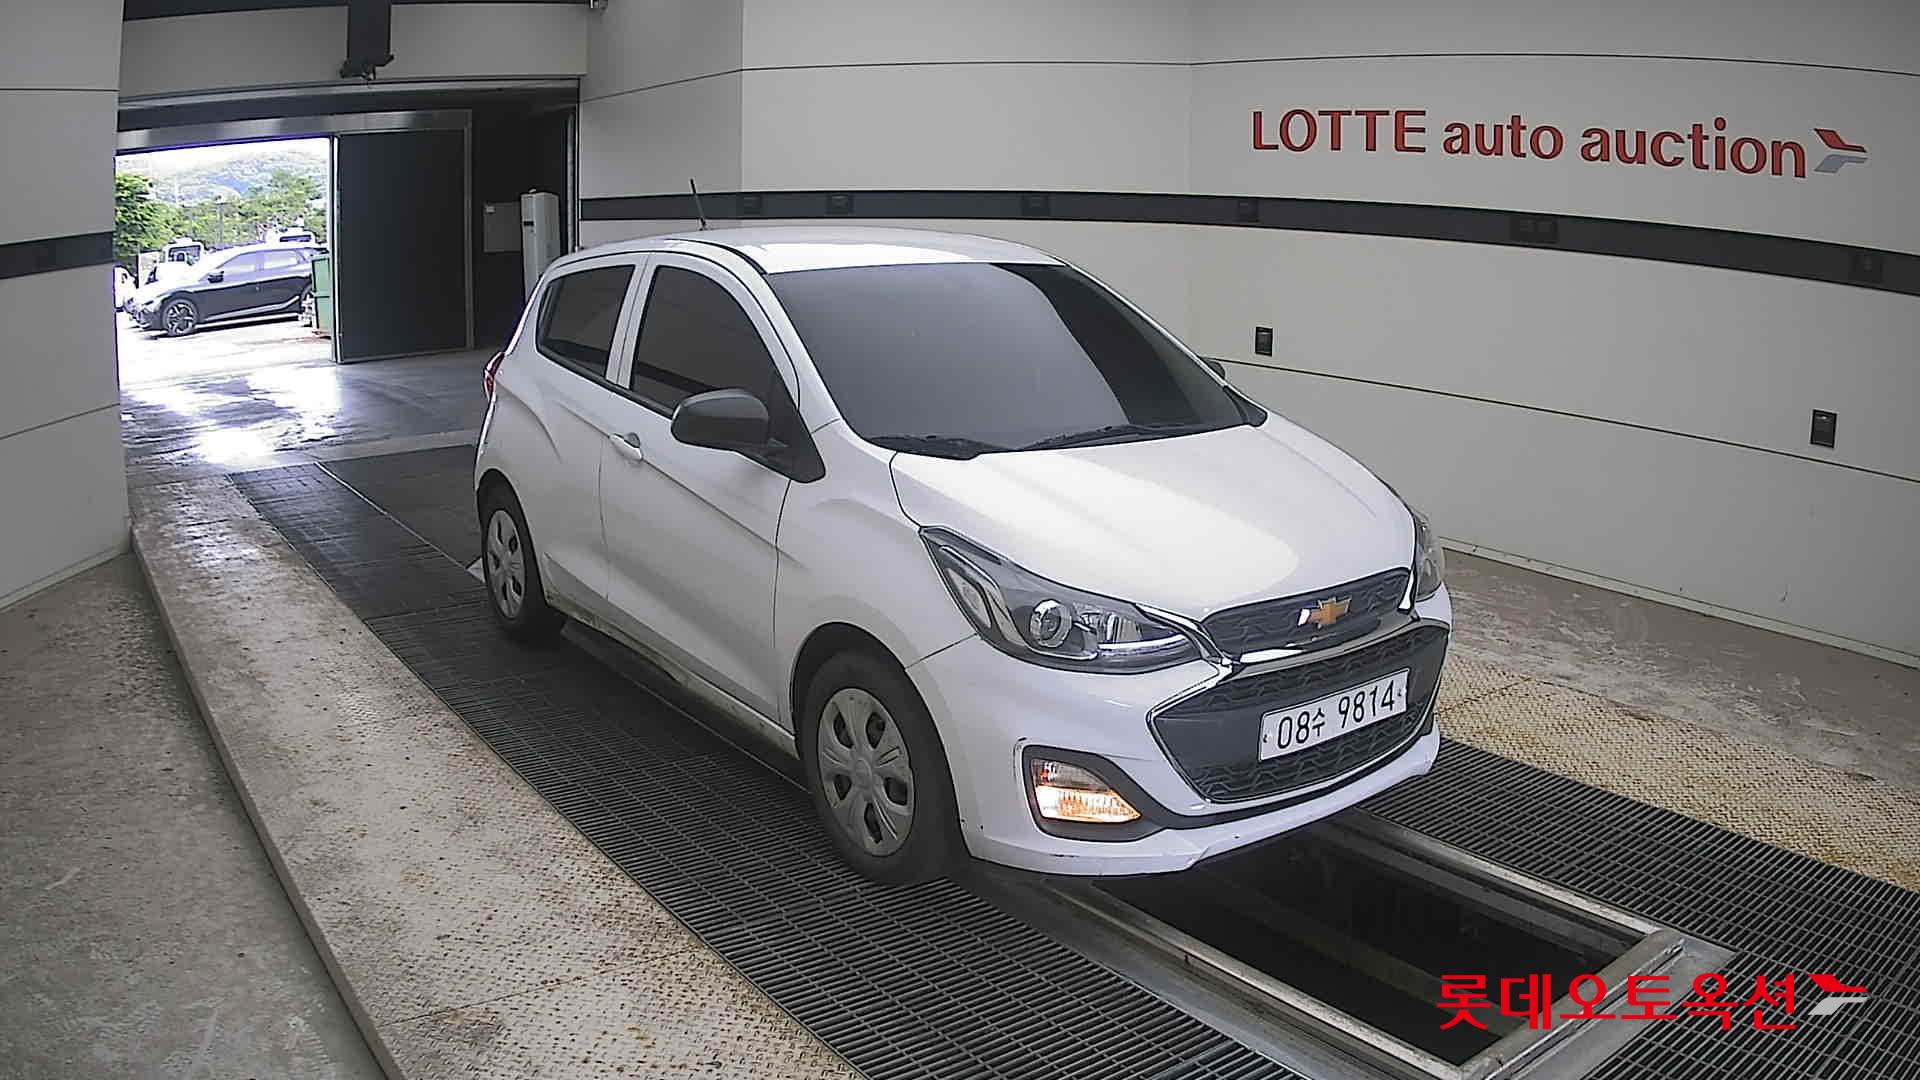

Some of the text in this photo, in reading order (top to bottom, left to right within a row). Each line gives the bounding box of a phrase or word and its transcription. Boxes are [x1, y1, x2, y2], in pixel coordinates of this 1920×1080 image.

[1252, 109, 1807, 179] LOTTE auto auction
[1277, 680, 1395, 750] 08수 9814
